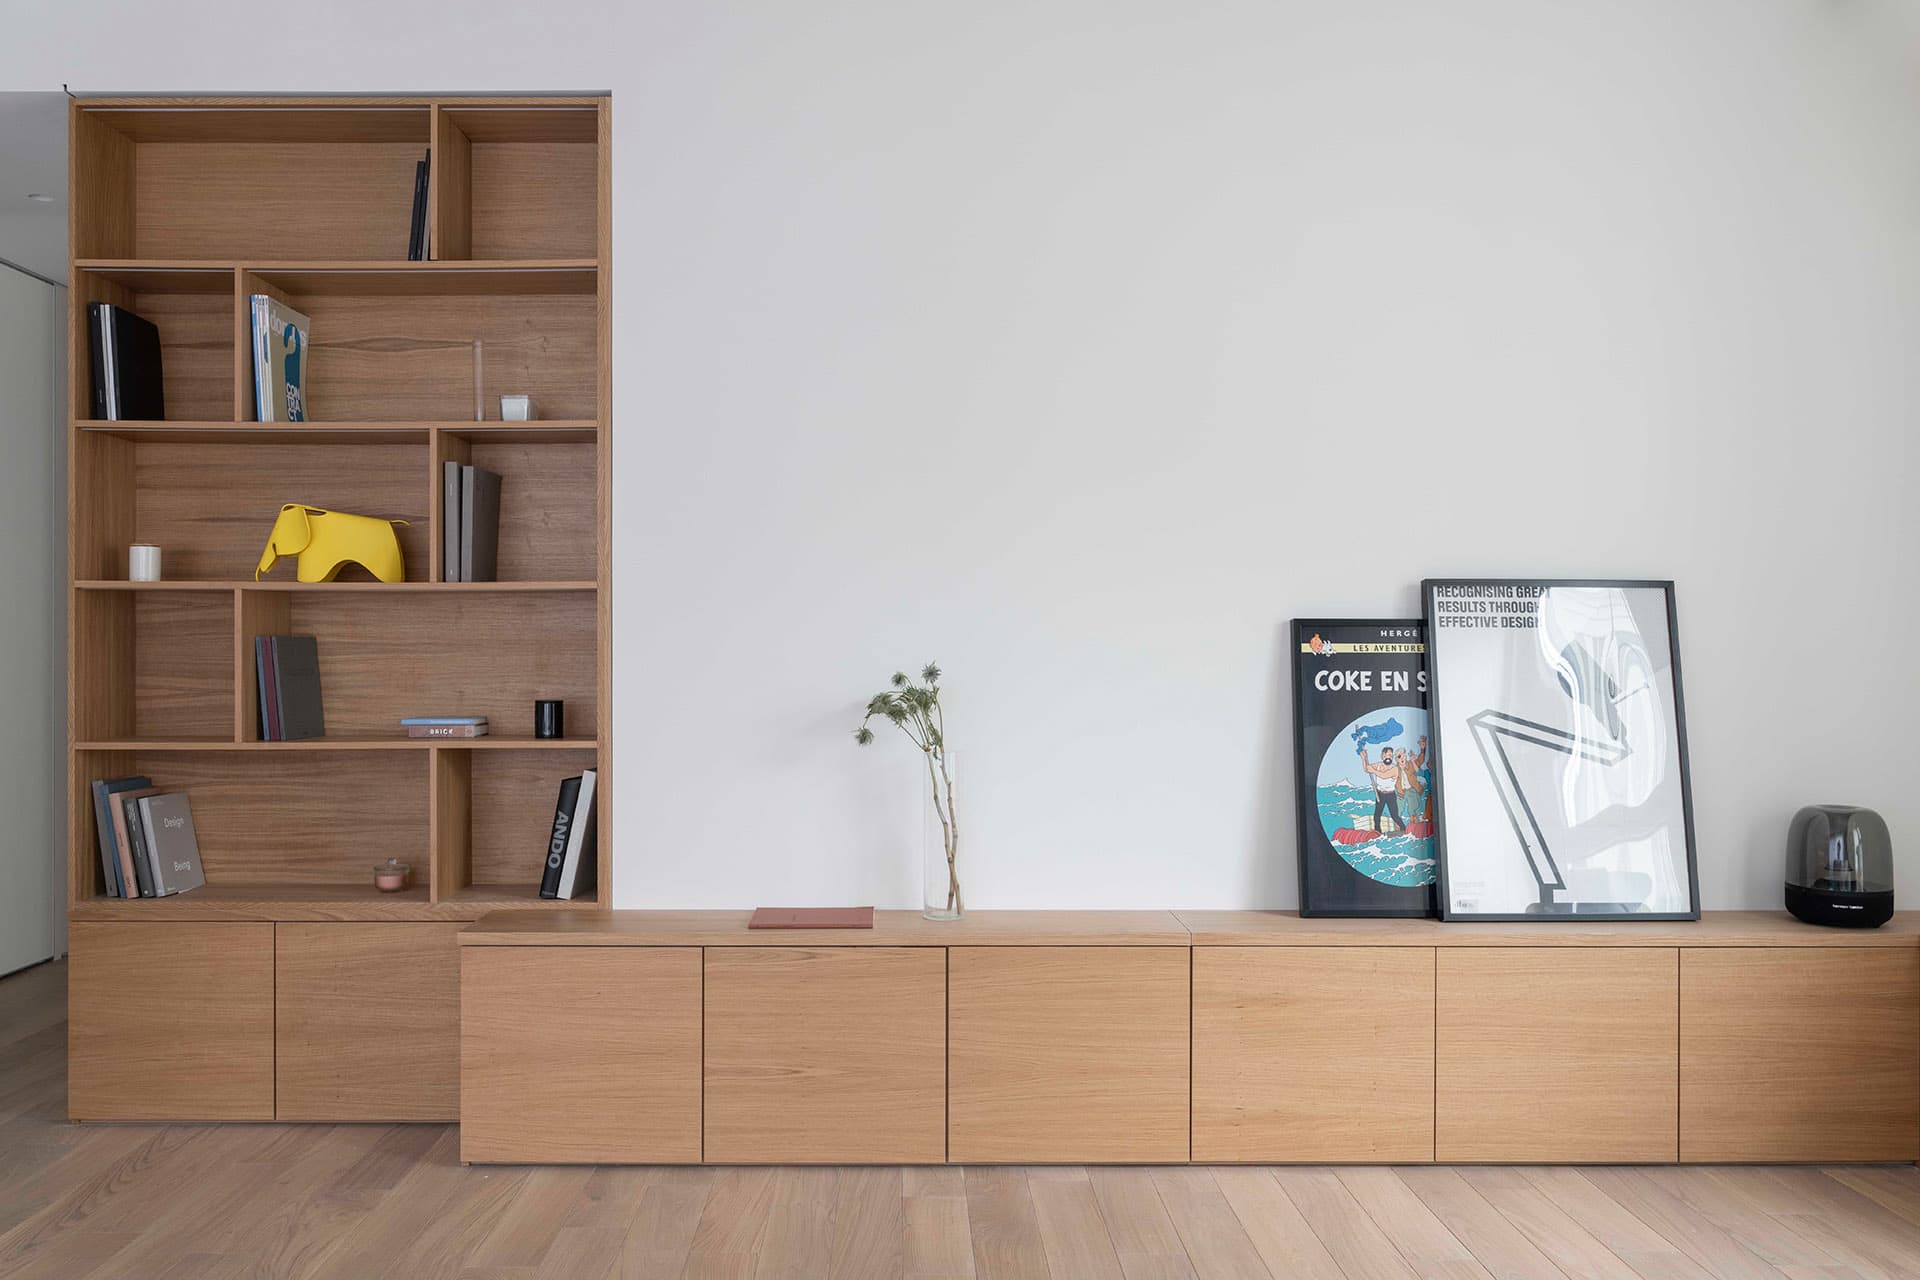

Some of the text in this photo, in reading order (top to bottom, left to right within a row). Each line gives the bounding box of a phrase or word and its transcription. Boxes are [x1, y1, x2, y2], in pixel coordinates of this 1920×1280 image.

[1437, 586, 1513, 598] RECOGNISING
[1438, 601, 1486, 613] RESULTS
[1440, 616, 1497, 628] EFFECTIVE
[1380, 629, 1418, 637] HERGÉ
[1314, 670, 1372, 691] COKE
[1381, 671, 1409, 691] EN
[163, 816, 184, 829] Design
[548, 810, 569, 869] ANDO
